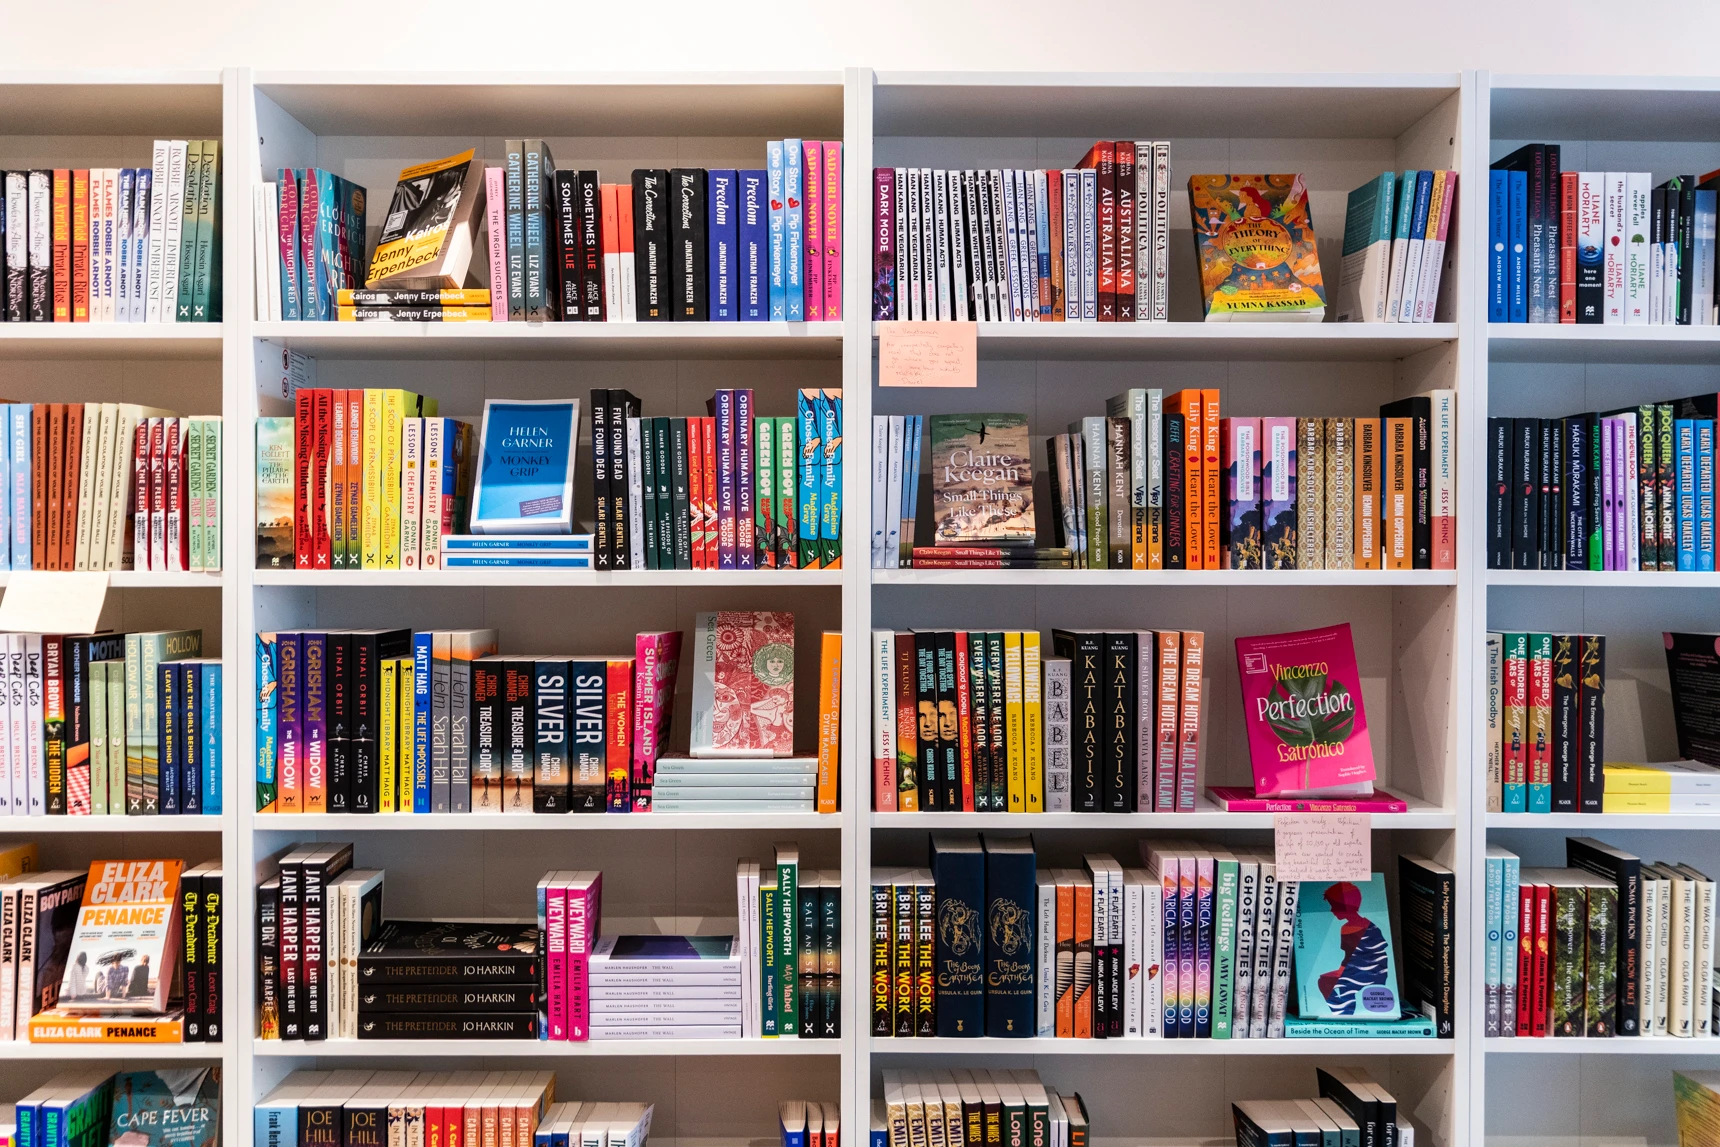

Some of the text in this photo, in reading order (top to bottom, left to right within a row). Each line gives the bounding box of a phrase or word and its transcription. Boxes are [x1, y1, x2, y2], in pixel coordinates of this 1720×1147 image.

[562, 182, 573, 244] SOMETIMES
[716, 178, 728, 225] Freedom
[1582, 183, 1590, 236] MORIARTY
[404, 221, 449, 244] Kairos
[508, 153, 521, 298] CATHERINE WHEEL LIZ EVANS
[880, 185, 888, 251] DARK MODE
[105, 220, 113, 256] ROBBIE
[1120, 189, 1131, 288] AUSTRALIANA
[1232, 229, 1280, 239] THEORY
[1534, 224, 1542, 273] Pheasants
[367, 248, 440, 280] Erpenbeck
[372, 245, 414, 266] Jenny
[566, 256, 574, 269] LIE
[350, 291, 465, 301] Kairos Jenny Erpenbeck
[494, 261, 503, 300] SUICIDES
[1227, 299, 1306, 309] YUMNA KASSAB
[510, 427, 547, 435] HELEN
[613, 407, 621, 425] FIVE
[721, 395, 729, 445] ORDINARY
[16, 415, 24, 463] SHY GIRL
[171, 424, 179, 455] TENDER
[502, 438, 553, 448] GARNER
[1115, 425, 1123, 469] HANNAH
[172, 457, 178, 468] IS
[500, 456, 551, 465] MONKEY
[510, 468, 539, 476] GRIP
[614, 459, 622, 480] DEAD
[722, 449, 730, 482] HUMAN
[945, 466, 1019, 484] Keegan
[950, 451, 1012, 469] Claire
[1151, 395, 1160, 543] The Passenger Seat Vijay Khurana
[1661, 410, 1672, 539] BOG QUEEN ANNA NORTH
[1187, 403, 1199, 550] Lily King Heart the Lover
[944, 490, 1022, 502] Small Things
[950, 505, 1017, 517] Like These
[166, 636, 199, 654] HOLLOW
[706, 616, 716, 662] Sea Green
[47, 643, 59, 718] BRYAN BROWN
[281, 647, 296, 722] GRISHAM
[487, 675, 497, 696] CHRIS
[1270, 661, 1328, 680] Vincenzo
[475, 671, 485, 702] HAMMER
[643, 648, 655, 756] SUMMER ISLAND
[1488, 648, 1499, 729] The Irish Goodbye
[576, 676, 602, 743] SILVER
[1085, 656, 1096, 788] KATABASIS
[1256, 692, 1353, 722] Perfection
[1589, 707, 1597, 739] Emergency
[49, 740, 61, 793] THE HIDDEN
[284, 741, 295, 789] WIDOW
[1588, 741, 1596, 763] George
[102, 862, 165, 882] ELIZA
[91, 882, 168, 903] CLARK
[1703, 889, 1711, 903] THE
[82, 908, 165, 926] PENANCE
[306, 870, 320, 961] JANE HARPER
[569, 897, 584, 953] WEYWARD
[782, 868, 791, 956] SALLY HEPWORTH
[1217, 873, 1235, 952] big feelings
[1240, 875, 1254, 977] GHOST CITIES
[899, 894, 911, 1013] BRI LEE THE WORK
[386, 994, 404, 1003] THE
[464, 994, 475, 1003] JO
[476, 994, 515, 1003] HARKIN
[34, 1028, 156, 1038] ELIZA CLARK PENANCE
[117, 1108, 209, 1128] CAPE FEVER
[307, 1111, 333, 1125] JOE
[306, 1130, 335, 1142] HILL
